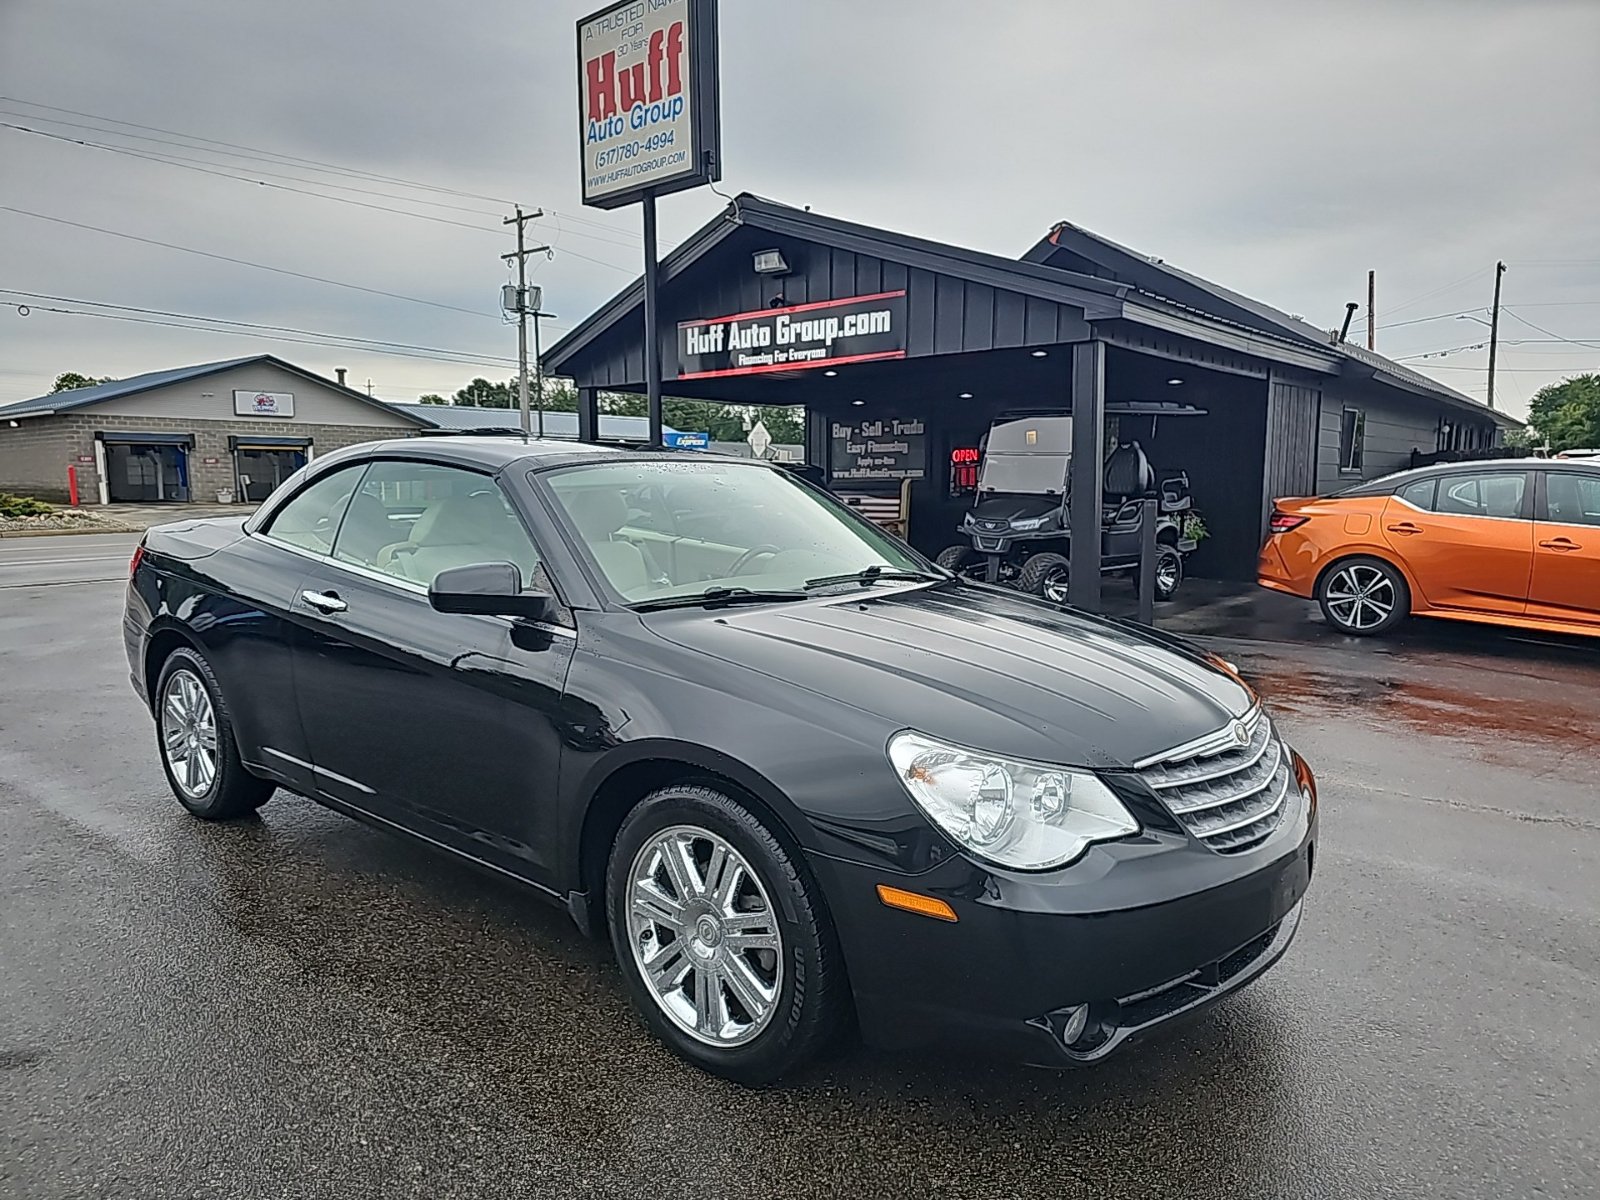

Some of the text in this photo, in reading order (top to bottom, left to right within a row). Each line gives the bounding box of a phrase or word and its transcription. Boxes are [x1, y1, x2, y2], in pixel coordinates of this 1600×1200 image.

[585, 27, 593, 41] A
[596, 3, 645, 35] TRUSTED
[621, 22, 643, 40] FOR
[617, 44, 628, 57] 30
[587, 21, 682, 122] Huff
[587, 96, 683, 145] Auto Group
[595, 130, 674, 169] (517)780-4994
[587, 150, 685, 187] WWW.HUFFAUTOGROUP.COM
[687, 310, 891, 355] Huff Auto Group.com
[738, 348, 826, 366] Financing For Everyone
[832, 423, 852, 440] Buy
[861, 421, 882, 437] Sell
[892, 418, 924, 435] Trade
[846, 440, 908, 455] Easy Financing
[952, 448, 978, 462] OPEN
